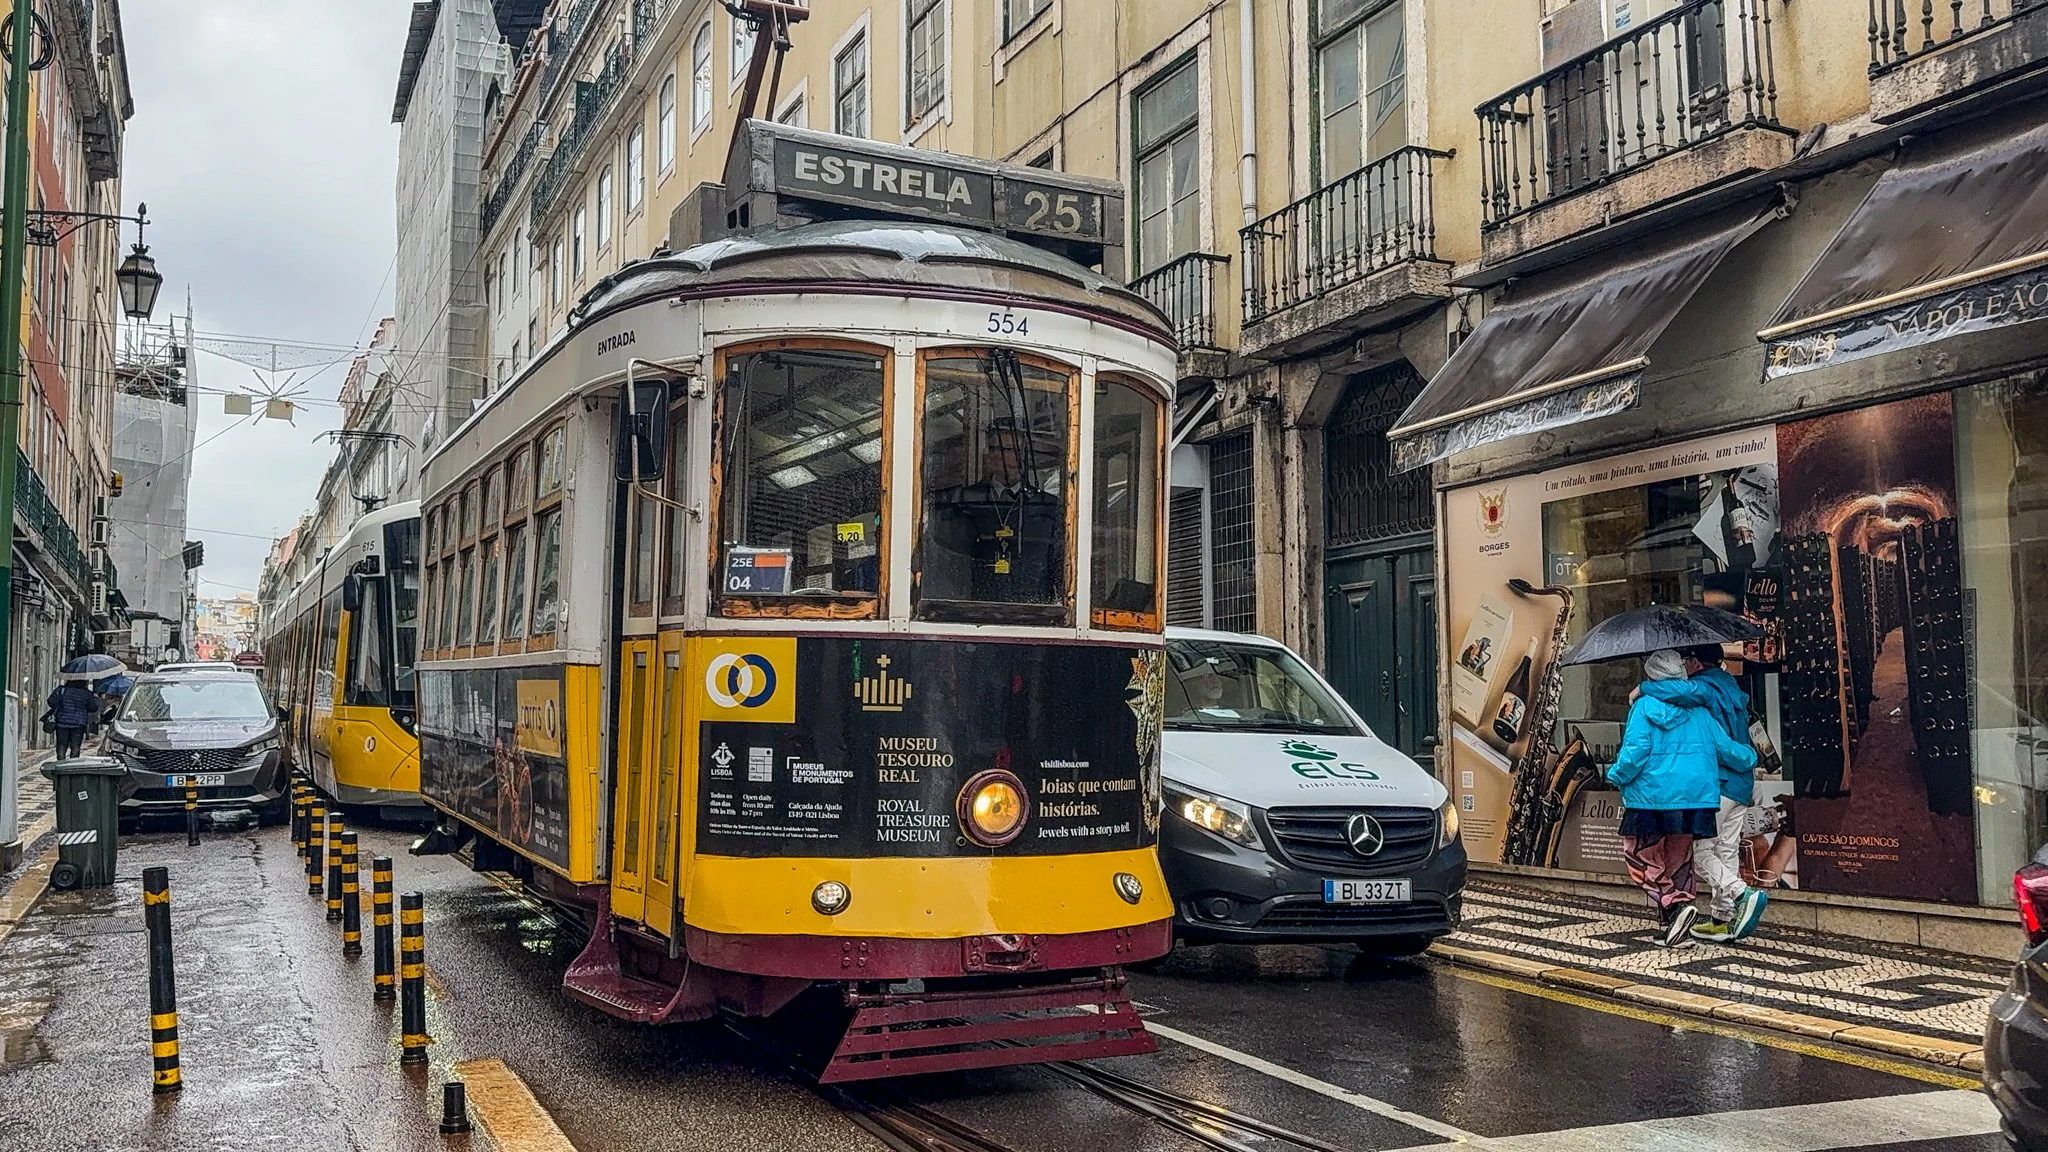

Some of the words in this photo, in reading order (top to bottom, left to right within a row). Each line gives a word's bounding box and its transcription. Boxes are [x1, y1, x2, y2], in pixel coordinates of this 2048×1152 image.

[794, 150, 973, 205] ESTRELA
[1024, 190, 1082, 233] 25
[1884, 282, 2048, 340] NAPOLEÃO
[987, 312, 1029, 337] 554
[597, 329, 636, 357] ENTRADA
[1545, 480, 1559, 493] Um
[1561, 474, 1588, 491] rótulo,
[1589, 471, 1608, 483] uma
[1648, 460, 1669, 472] uma
[1670, 449, 1710, 468] história,
[1715, 445, 1732, 459] um
[1734, 437, 1767, 455] vinho!
[362, 540, 375, 553] 615
[1479, 541, 1510, 553] BORGES
[731, 557, 753, 568] 25E
[729, 576, 751, 590] 04
[1747, 578, 1778, 596] Lello
[879, 737, 938, 751] MUSEU
[877, 753, 954, 767] TESOURO
[1040, 760, 1090, 769] visitlisboa.com
[711, 768, 733, 776] LISBOA
[878, 769, 920, 783] REAL
[1291, 761, 1380, 781] ELS
[1039, 778, 1075, 794] Joias
[1078, 780, 1101, 797] que
[1102, 778, 1136, 792] contam
[758, 794, 772, 802] daily
[788, 802, 814, 811] Calçada
[814, 802, 823, 810] da
[824, 803, 843, 811] Ajuda
[877, 799, 924, 812] ROYAL
[1039, 800, 1100, 818] histórias.
[1580, 799, 1614, 819] Lello
[818, 811, 840, 819] Lisboa
[876, 814, 951, 828] TREASURE
[876, 829, 941, 842] MUSEUM
[1038, 826, 1069, 839] Jewels
[1070, 825, 1089, 837] with
[1089, 827, 1095, 836] a
[1095, 825, 1113, 837] story
[1113, 824, 1120, 834] to
[1802, 833, 1829, 844] CAVES
[1848, 835, 1900, 848] DOMINGOS
[1342, 882, 1403, 900] BL33ZT
